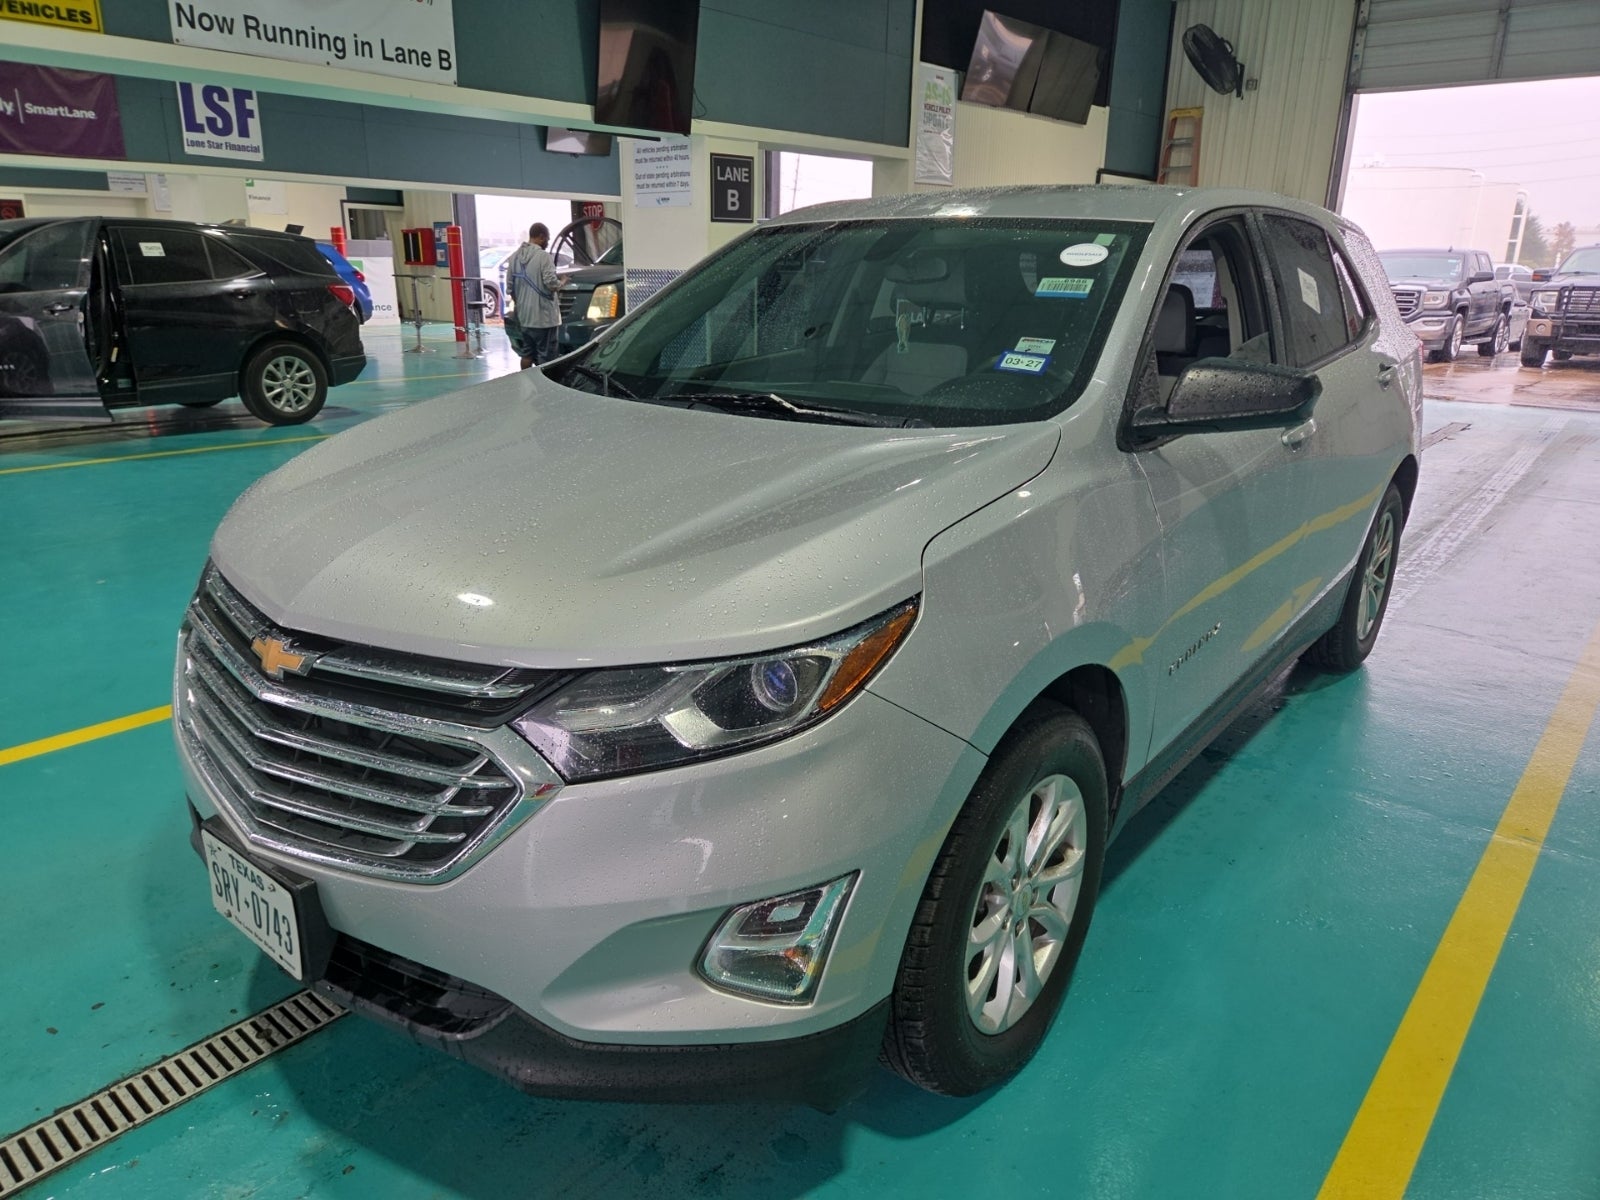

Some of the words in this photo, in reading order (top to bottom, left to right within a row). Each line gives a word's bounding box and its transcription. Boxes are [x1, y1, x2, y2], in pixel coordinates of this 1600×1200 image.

[175, 2, 235, 35] Now
[243, 14, 346, 60] Running
[353, 33, 373, 58] in
[380, 38, 432, 68] Lane
[438, 48, 452, 71] B
[24, 103, 97, 119] SmartLane
[179, 81, 255, 139] LSF
[186, 138, 205, 149] Lone
[207, 139, 223, 150] Star
[224, 141, 261, 154] Financial
[716, 166, 750, 183] LANE
[727, 189, 740, 211] B
[583, 204, 603, 217] STOP
[228, 853, 265, 892] TEXAS
